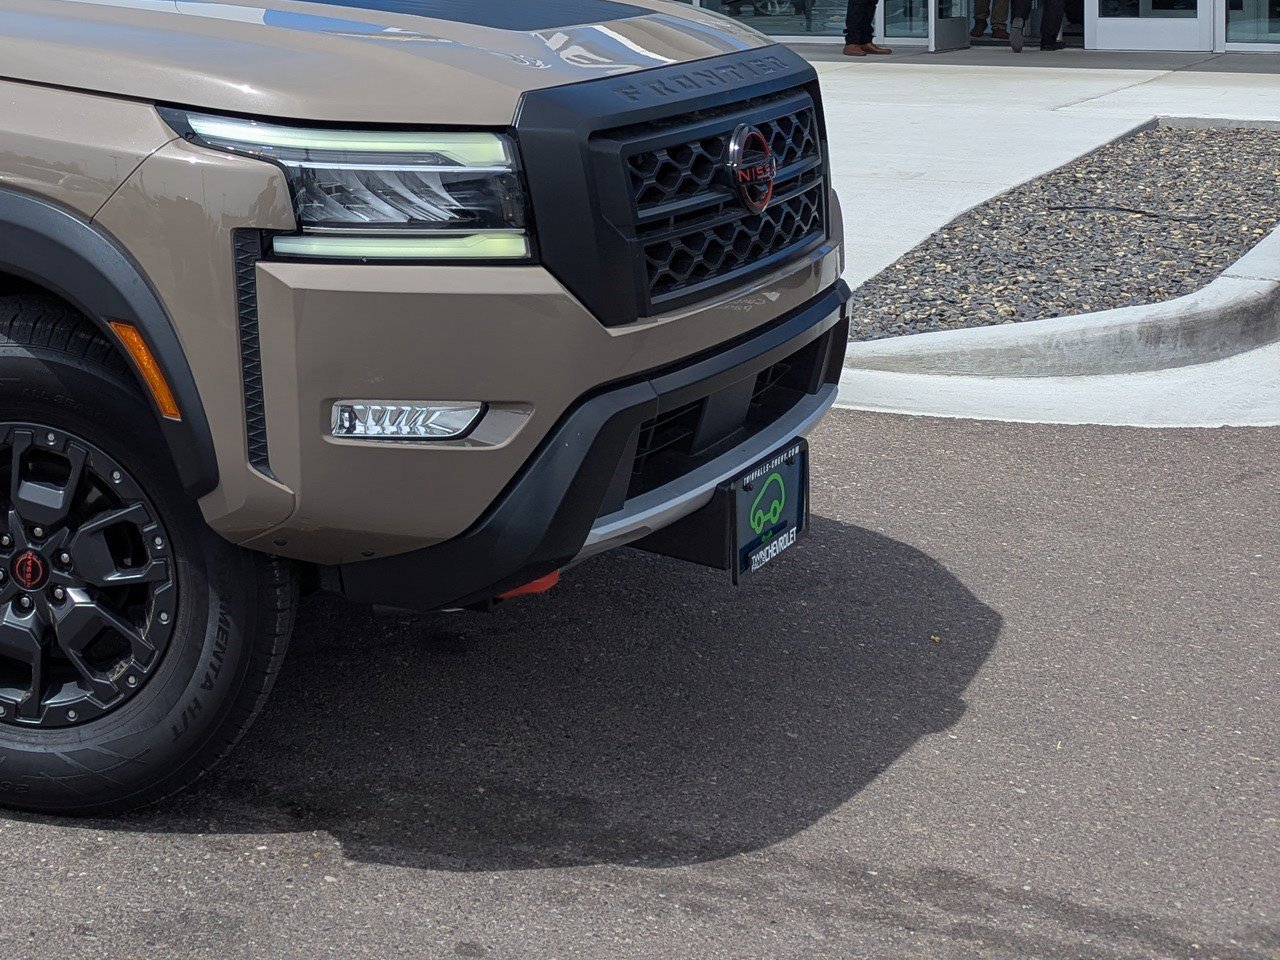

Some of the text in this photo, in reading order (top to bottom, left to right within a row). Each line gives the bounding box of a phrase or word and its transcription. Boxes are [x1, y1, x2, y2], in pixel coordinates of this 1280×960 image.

[612, 55, 790, 102] FRONTIER
[764, 526, 797, 563] CHEVROLET
[170, 696, 203, 741] H/T
